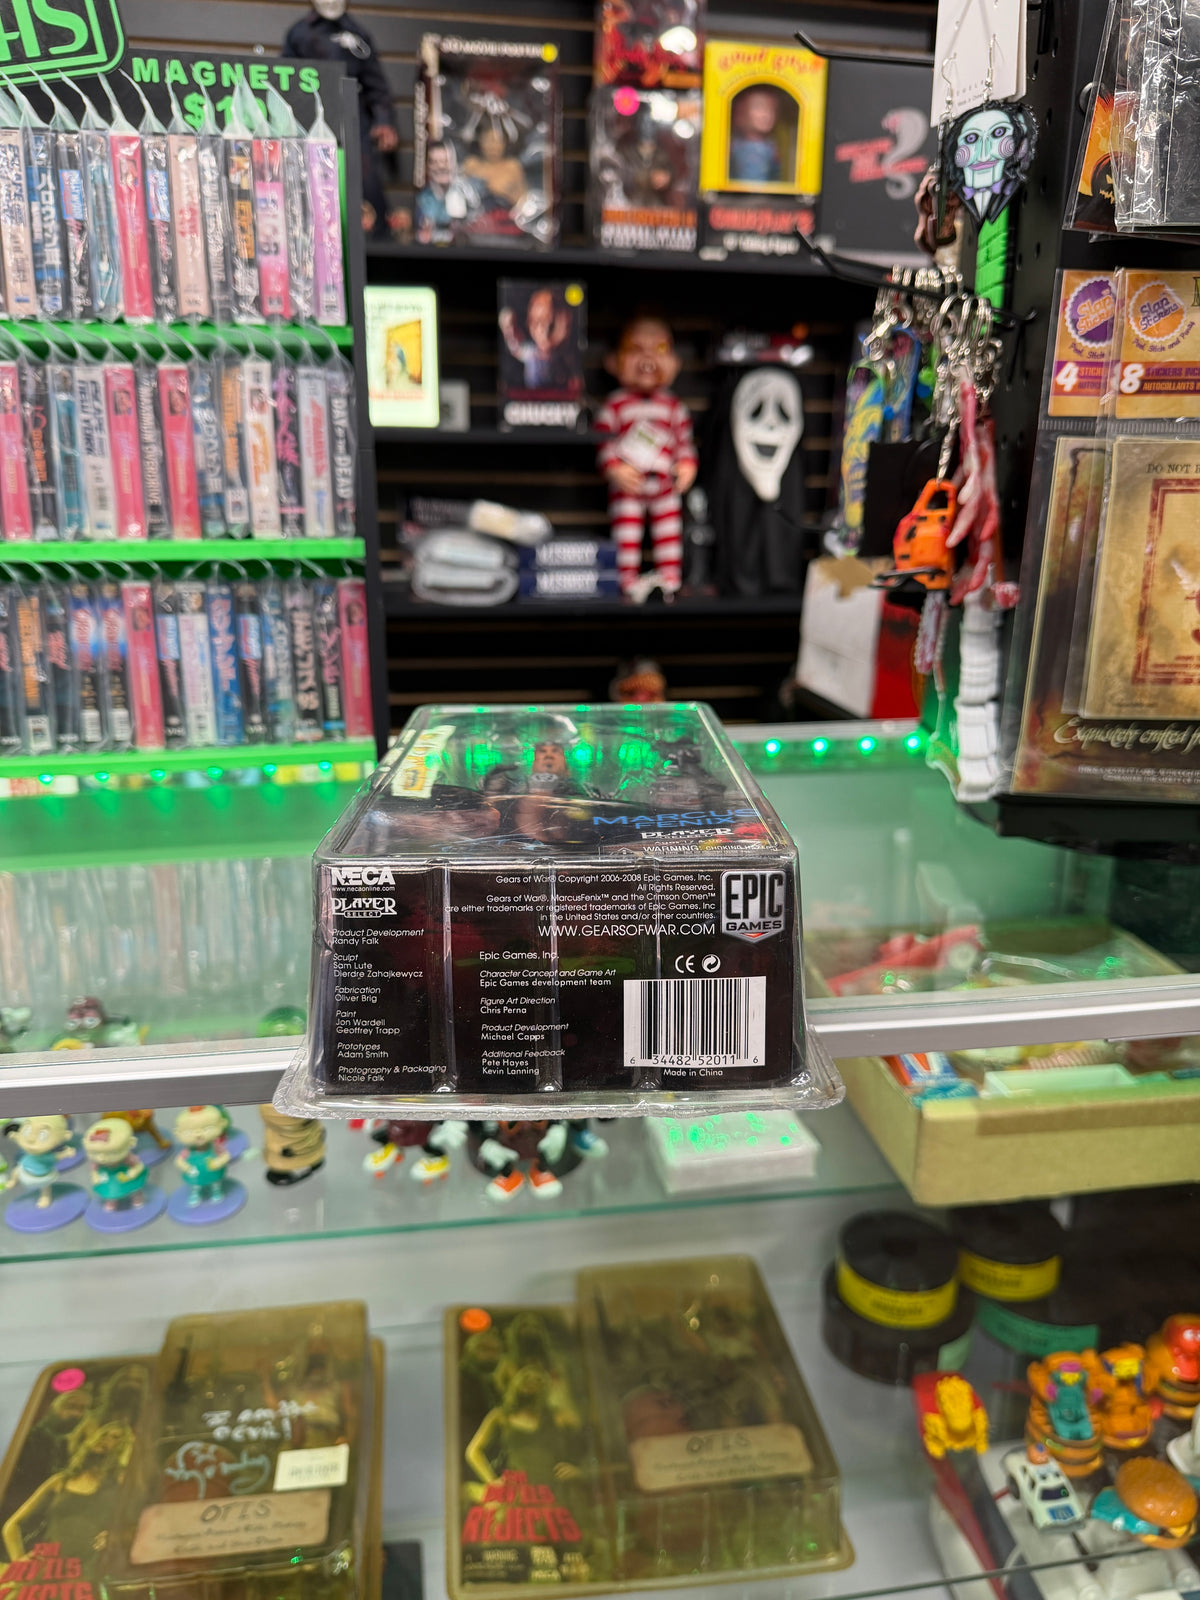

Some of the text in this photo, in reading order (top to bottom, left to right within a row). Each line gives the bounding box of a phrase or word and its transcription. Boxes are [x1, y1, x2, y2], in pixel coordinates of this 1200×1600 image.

[132, 57, 320, 93] MAGNETS
[1077, 295, 1112, 317] Slap
[1140, 297, 1170, 317] Slap
[1140, 303, 1179, 331] Stickers
[1056, 362, 1078, 391] 4
[1120, 363, 1144, 394] 8
[144, 443, 161, 505] OVERDRIVE
[1146, 464, 1163, 473] DO
[1166, 464, 1191, 474] NOT
[335, 456, 353, 499] DEAD
[592, 809, 758, 825] MARCUS
[635, 817, 736, 829] FENIX
[640, 828, 734, 839] PLAYER
[331, 867, 396, 886] NECA
[523, 875, 531, 883] of
[558, 875, 599, 884] Copyright
[643, 874, 661, 882] Epic
[649, 884, 673, 892] Rights
[647, 893, 679, 901] Crimson
[725, 874, 784, 919] EPIC
[332, 898, 396, 915] PLAYER
[487, 904, 533, 912] trademarks
[546, 904, 587, 912] registered
[589, 903, 636, 911] trademarks
[649, 903, 666, 912] Epic
[621, 912, 650, 920] and/or
[652, 912, 673, 920] other
[538, 924, 715, 936] WWW.GEARSOFWAR.COM
[726, 920, 782, 931] GAMES
[332, 929, 424, 938] Product Development
[332, 937, 379, 946] Randy Falk
[333, 954, 358, 963] Sculpt
[479, 951, 499, 961] Epic
[542, 951, 560, 959] Inc.
[333, 962, 372, 970] Sam Lute
[675, 955, 695, 973] CE
[333, 970, 365, 978] Dierdre
[480, 970, 521, 978] Character
[522, 969, 558, 978] Concept
[577, 969, 602, 977] Game
[480, 978, 612, 988] Epic Games development team
[335, 986, 381, 994] Fabrication
[335, 994, 377, 1003] Oliver Brig
[480, 998, 504, 1006] Figure
[336, 1010, 356, 1018] Paint
[480, 1006, 501, 1014] Chris
[336, 1027, 400, 1035] Geoffrey Trapp
[514, 1024, 569, 1032] Development
[481, 1033, 545, 1042] Michael Capps
[337, 1043, 381, 1051] Prototypes
[524, 1049, 565, 1057] Feedback
[502, 1059, 529, 1067] Hayes
[652, 1055, 691, 1065] 34482
[698, 1055, 735, 1065] 52011
[339, 1066, 392, 1075] Photography
[402, 1065, 446, 1073] Packaging
[507, 1067, 539, 1075] Lanning
[338, 1074, 365, 1082] Nicole
[686, 1433, 750, 1453] OTIS
[201, 1499, 272, 1523] OTIS
[462, 1506, 582, 1542] REJECTS
